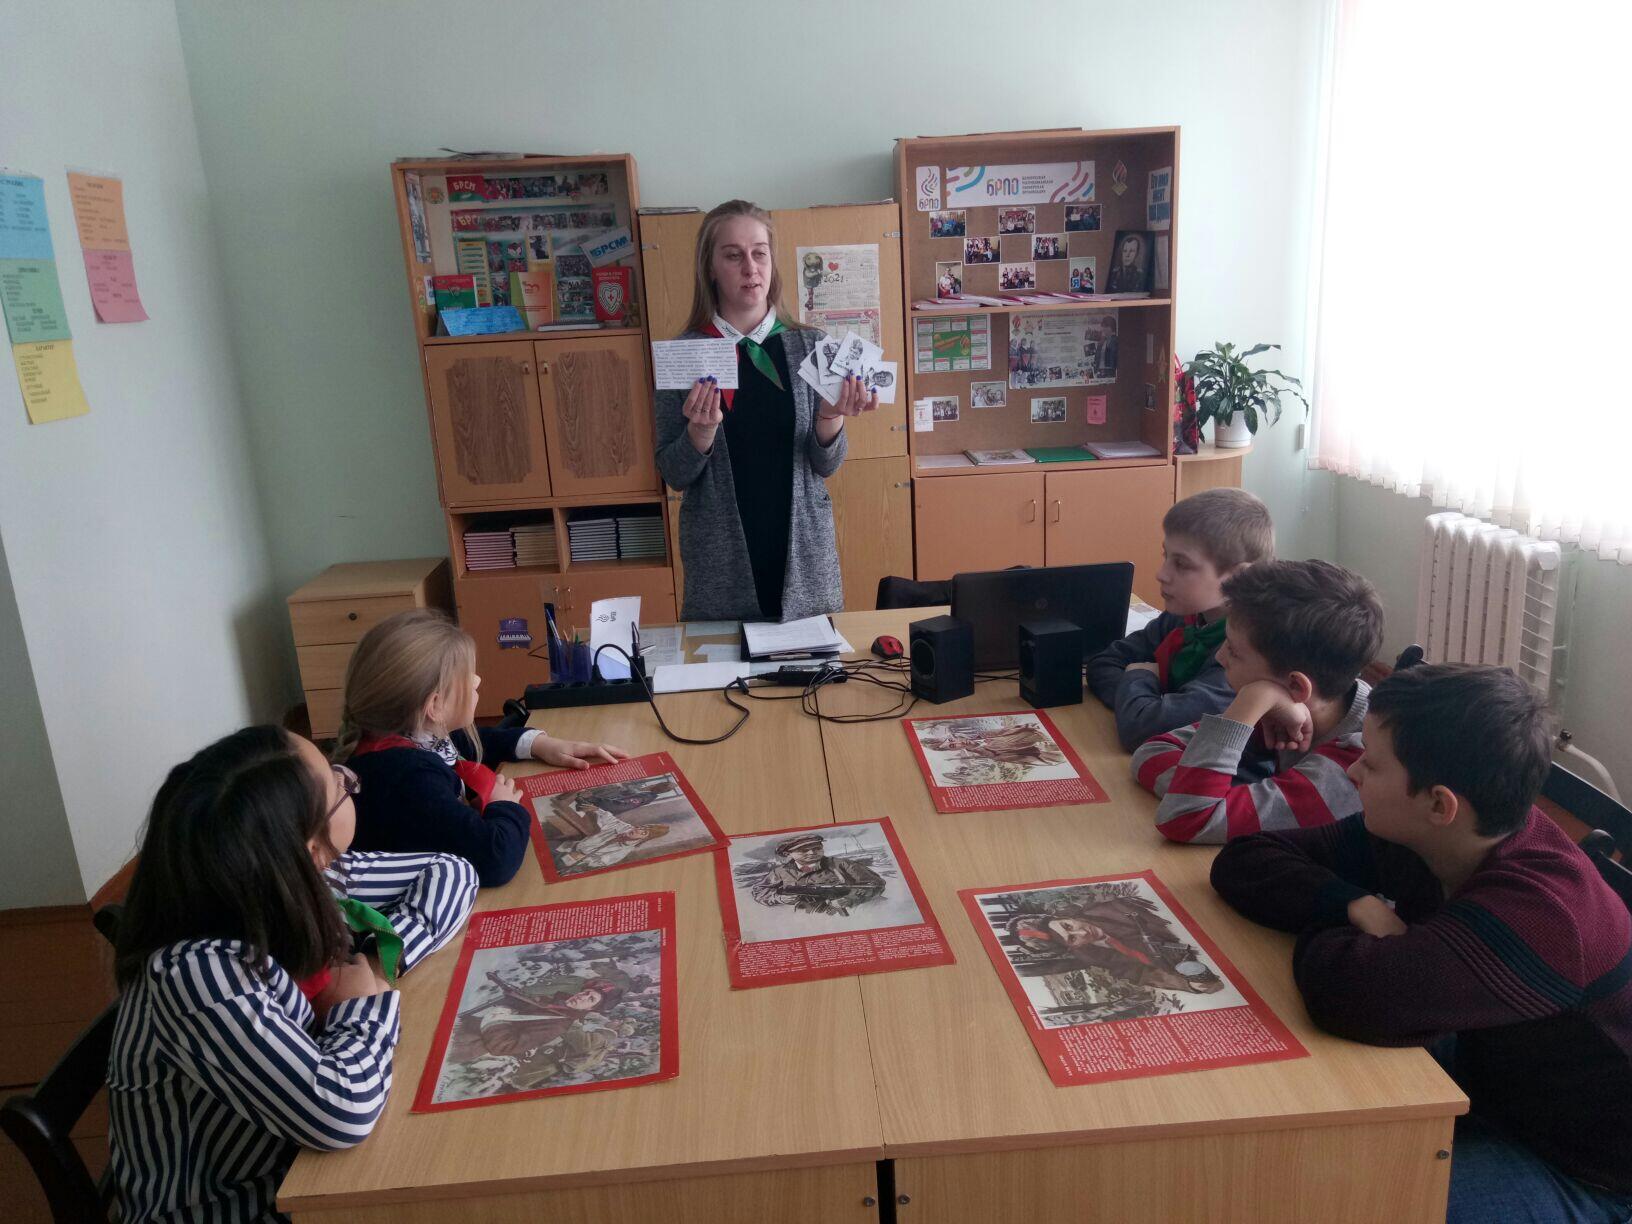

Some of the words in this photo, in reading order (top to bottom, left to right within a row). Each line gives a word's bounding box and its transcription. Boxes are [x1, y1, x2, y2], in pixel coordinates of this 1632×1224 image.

[453, 179, 476, 190] БРСМ
[986, 177, 1019, 196] БРПО
[918, 198, 939, 210] БРПО
[590, 237, 628, 256] БРСМ
